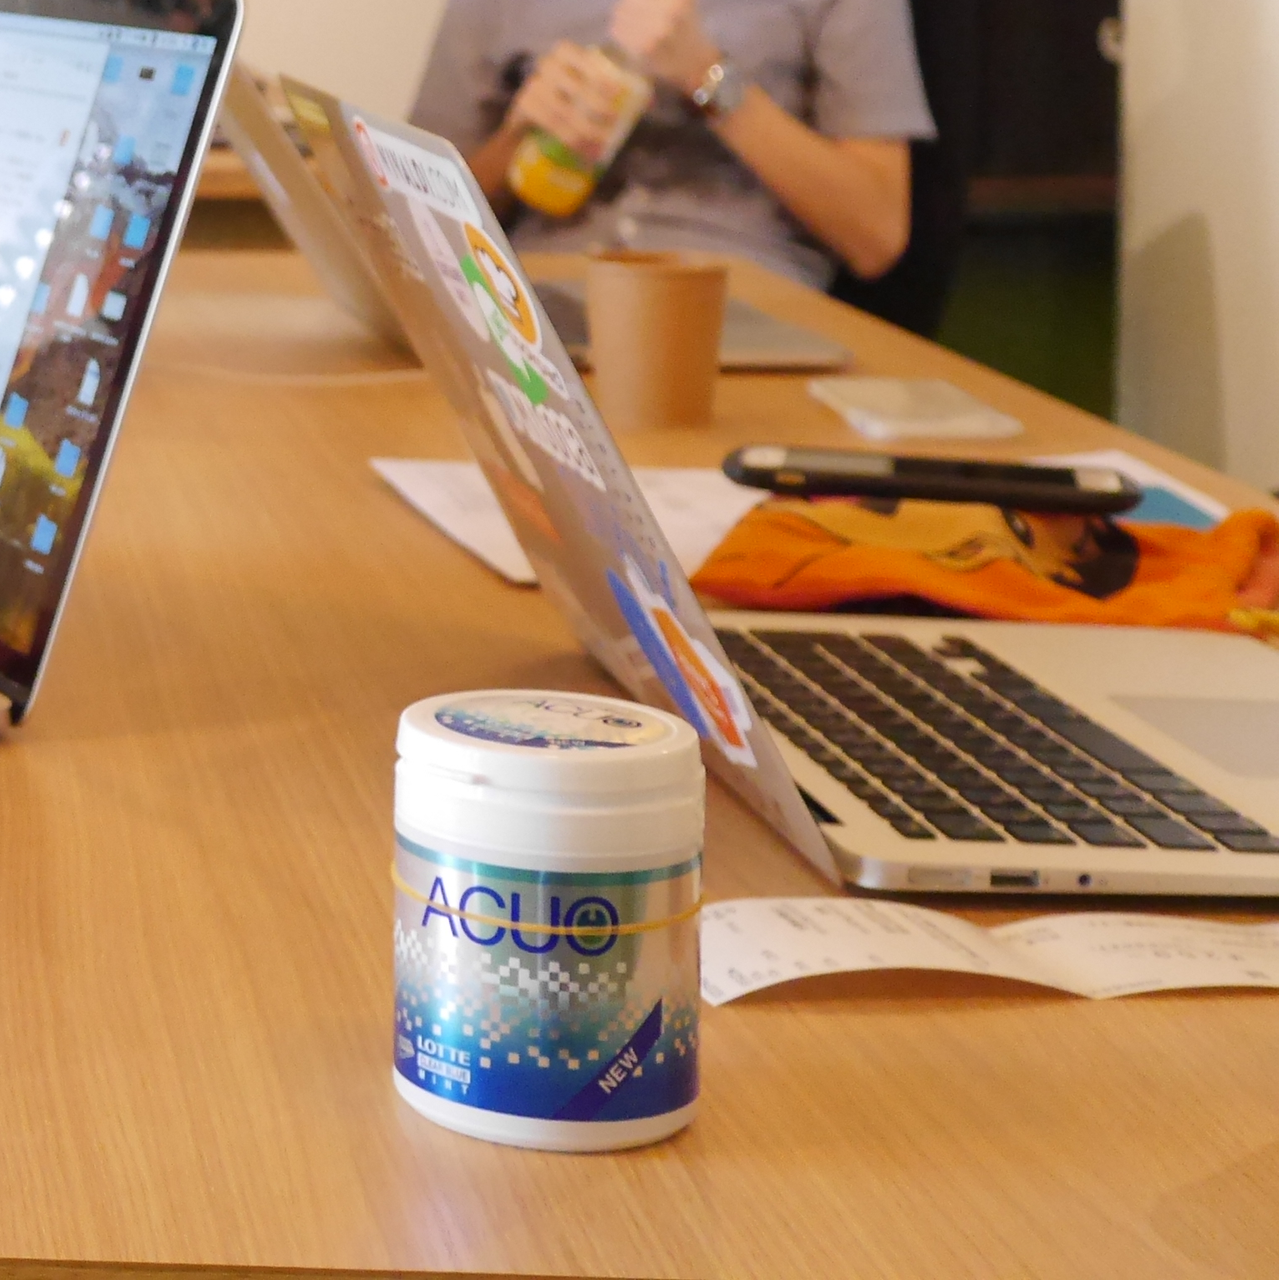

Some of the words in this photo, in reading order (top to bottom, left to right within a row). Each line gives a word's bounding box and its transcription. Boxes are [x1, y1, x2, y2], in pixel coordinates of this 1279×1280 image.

[421, 875, 620, 957] ACUO
[417, 1034, 471, 1067] LOTTE
[597, 1046, 639, 1095] NEW
